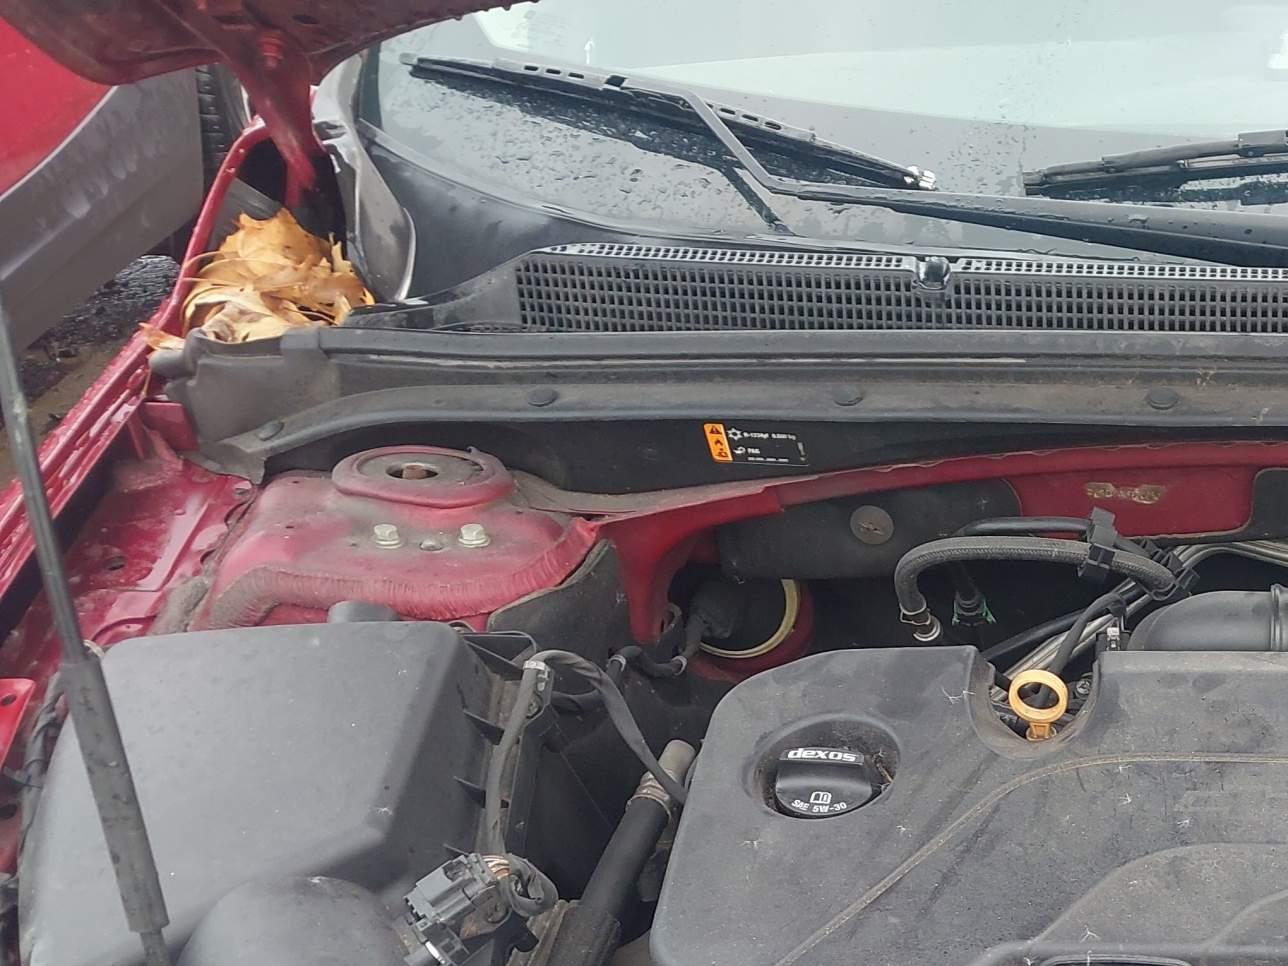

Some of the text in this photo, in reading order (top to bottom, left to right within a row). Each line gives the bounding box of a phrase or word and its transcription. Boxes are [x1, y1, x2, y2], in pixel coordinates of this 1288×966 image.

[787, 747, 857, 762] dexos
[791, 799, 847, 813] SAE 5W-30
